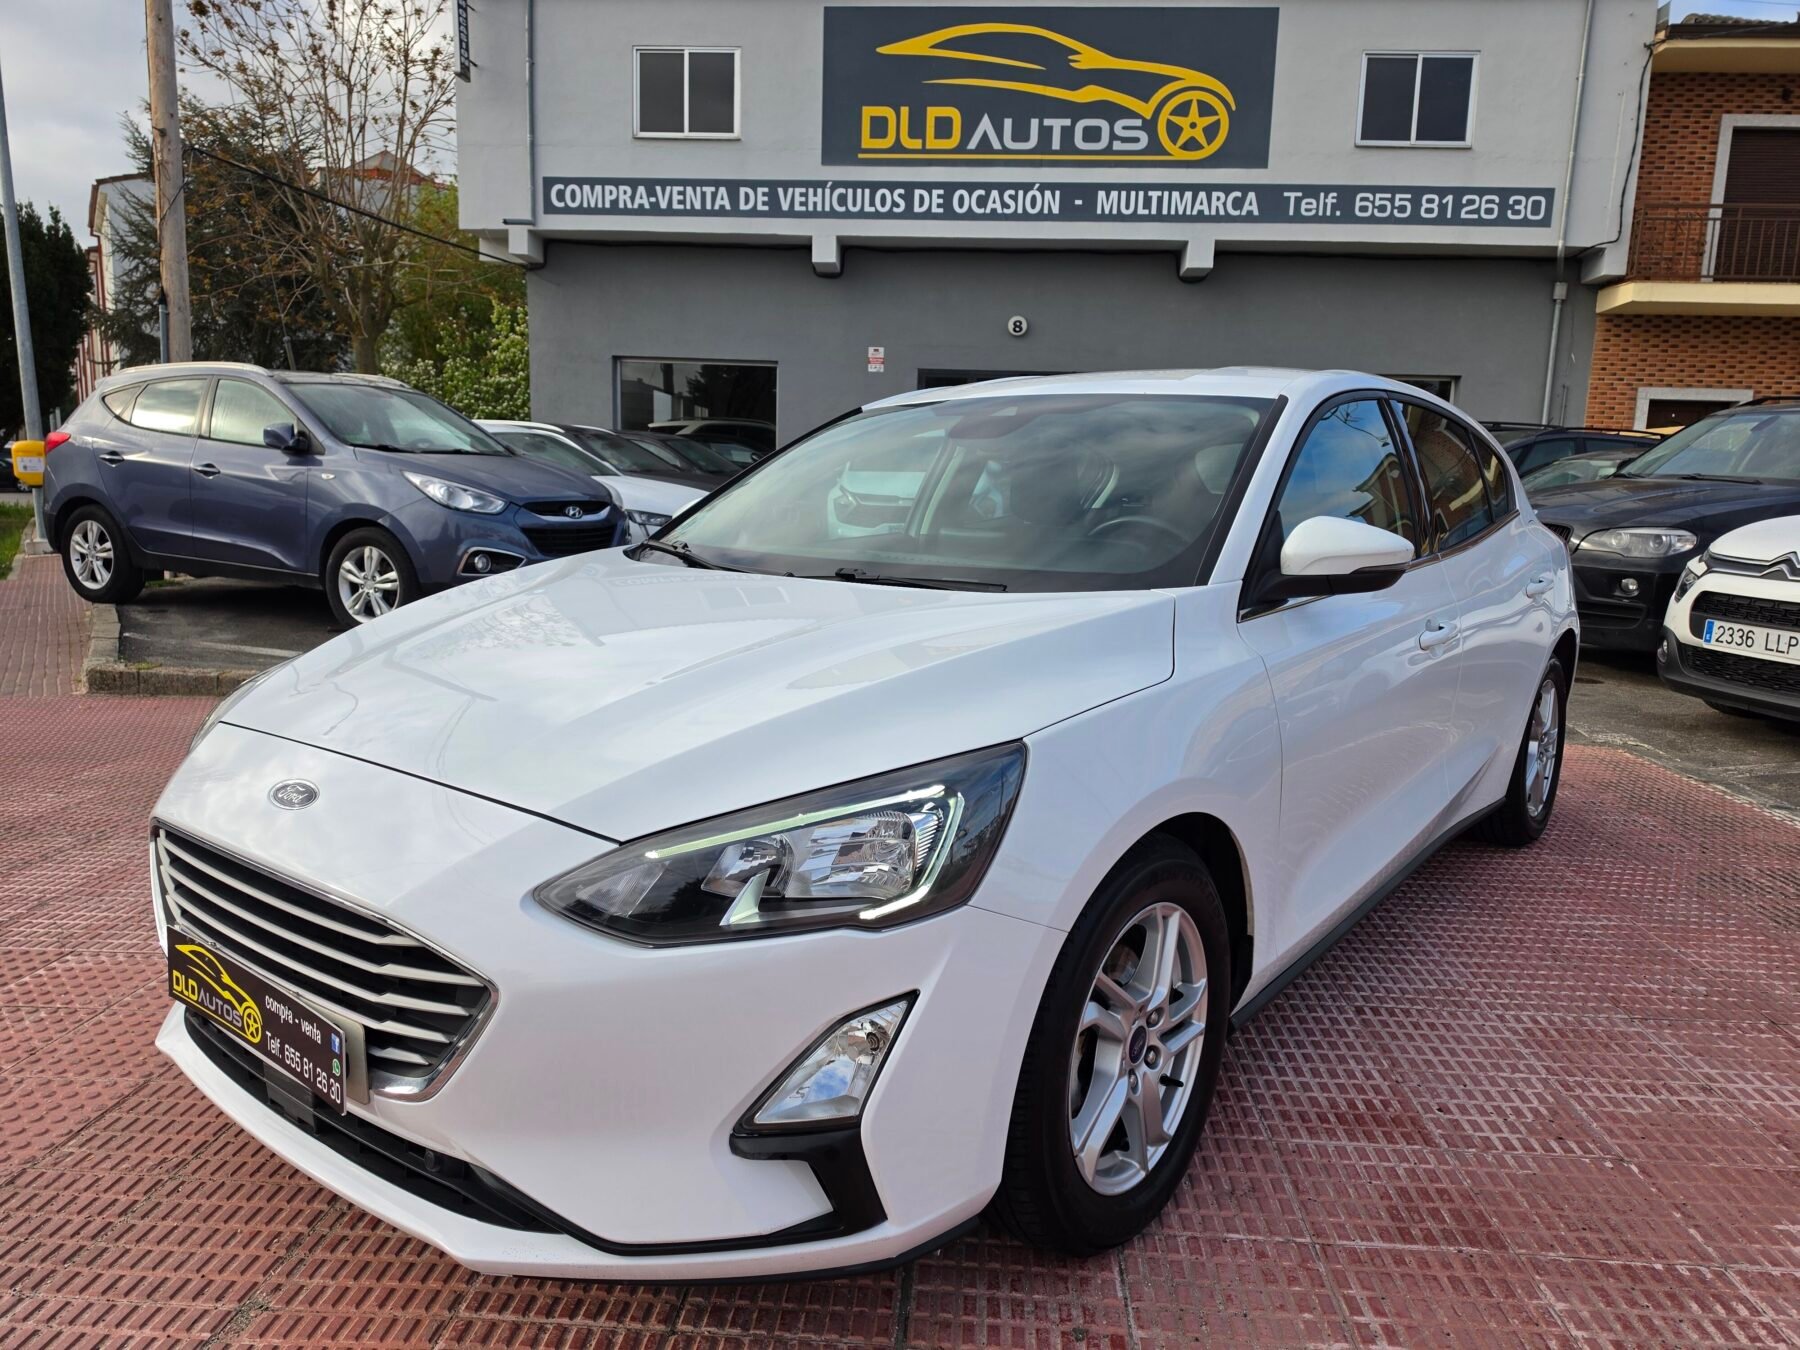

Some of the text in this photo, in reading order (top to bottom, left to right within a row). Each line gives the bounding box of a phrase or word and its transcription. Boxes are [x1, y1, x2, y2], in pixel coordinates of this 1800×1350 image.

[861, 105, 1149, 151] DLD AUTOS
[550, 183, 731, 211] COMPRA-VENTA
[738, 187, 769, 211] DE
[777, 182, 905, 213] VEHÍCULOS
[913, 189, 944, 213] DE
[952, 183, 1060, 214] OCASIÓN
[1096, 190, 1259, 216] MULTIMARCA
[1283, 191, 1342, 217] Telf.
[1354, 193, 1412, 218] 655
[1506, 195, 1547, 220] 30
[1012, 319, 1023, 334] 8
[1715, 625, 1799, 655] 2336 LLP
[172, 969, 243, 1028] DLD AUTOS
[265, 995, 293, 1025] compra
[300, 1017, 322, 1045] venta
[284, 1044, 301, 1072] 655
[303, 1059, 314, 1081] 81
[316, 1067, 328, 1093] 26
[330, 1077, 341, 1105] 30
